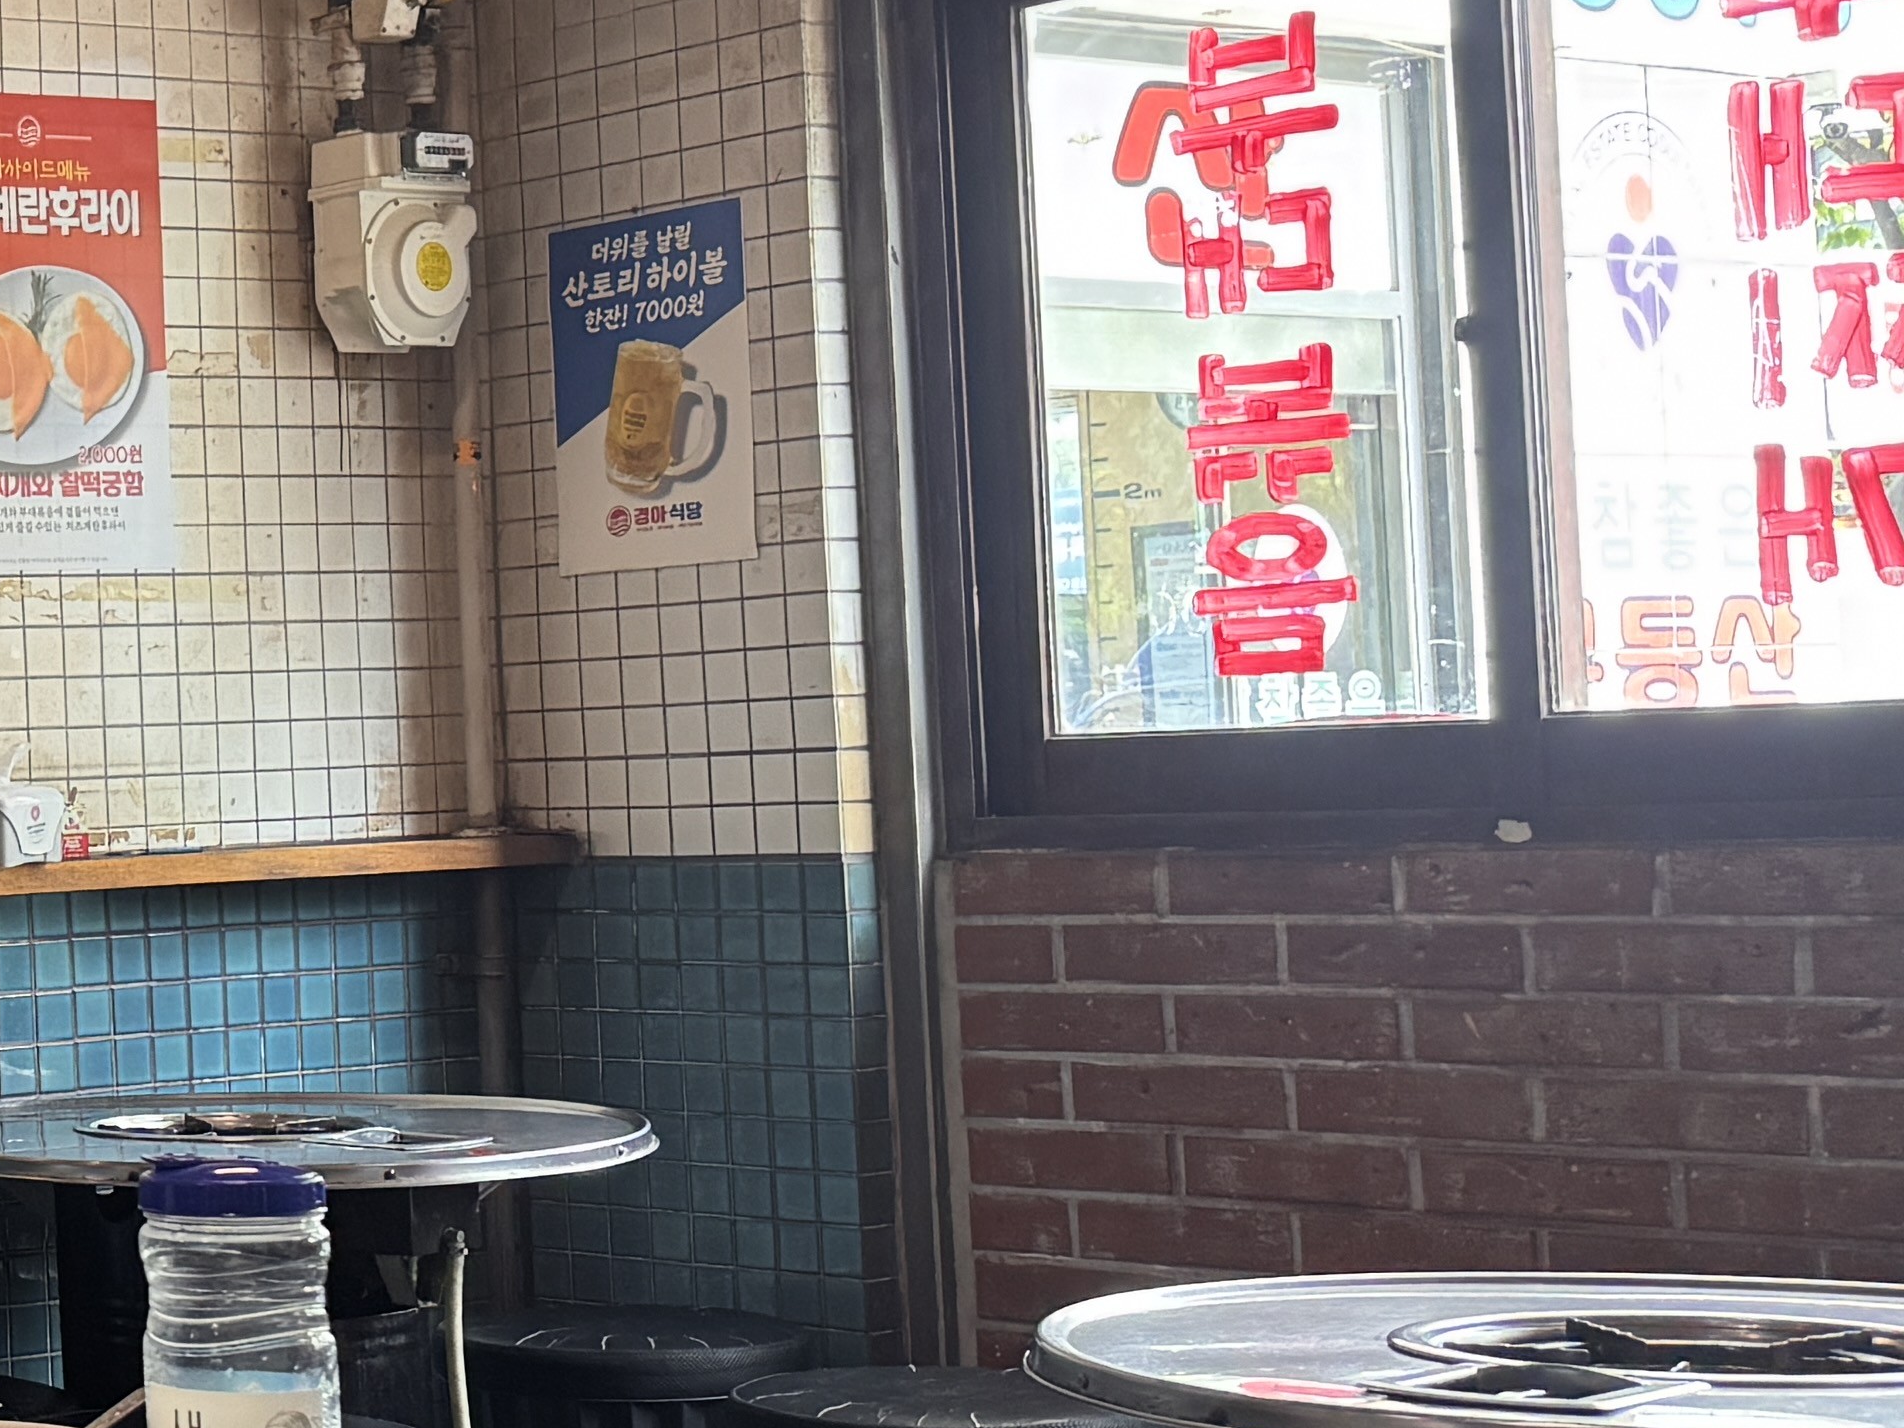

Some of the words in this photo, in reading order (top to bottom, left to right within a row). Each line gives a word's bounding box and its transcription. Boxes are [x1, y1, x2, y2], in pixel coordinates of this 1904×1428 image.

[591, 230, 650, 263] 더위를
[584, 304, 629, 334] 한잔!
[634, 289, 705, 325] 7000원
[59, 470, 144, 498] 찰떡궁합
[1582, 595, 1801, 709] 동산
